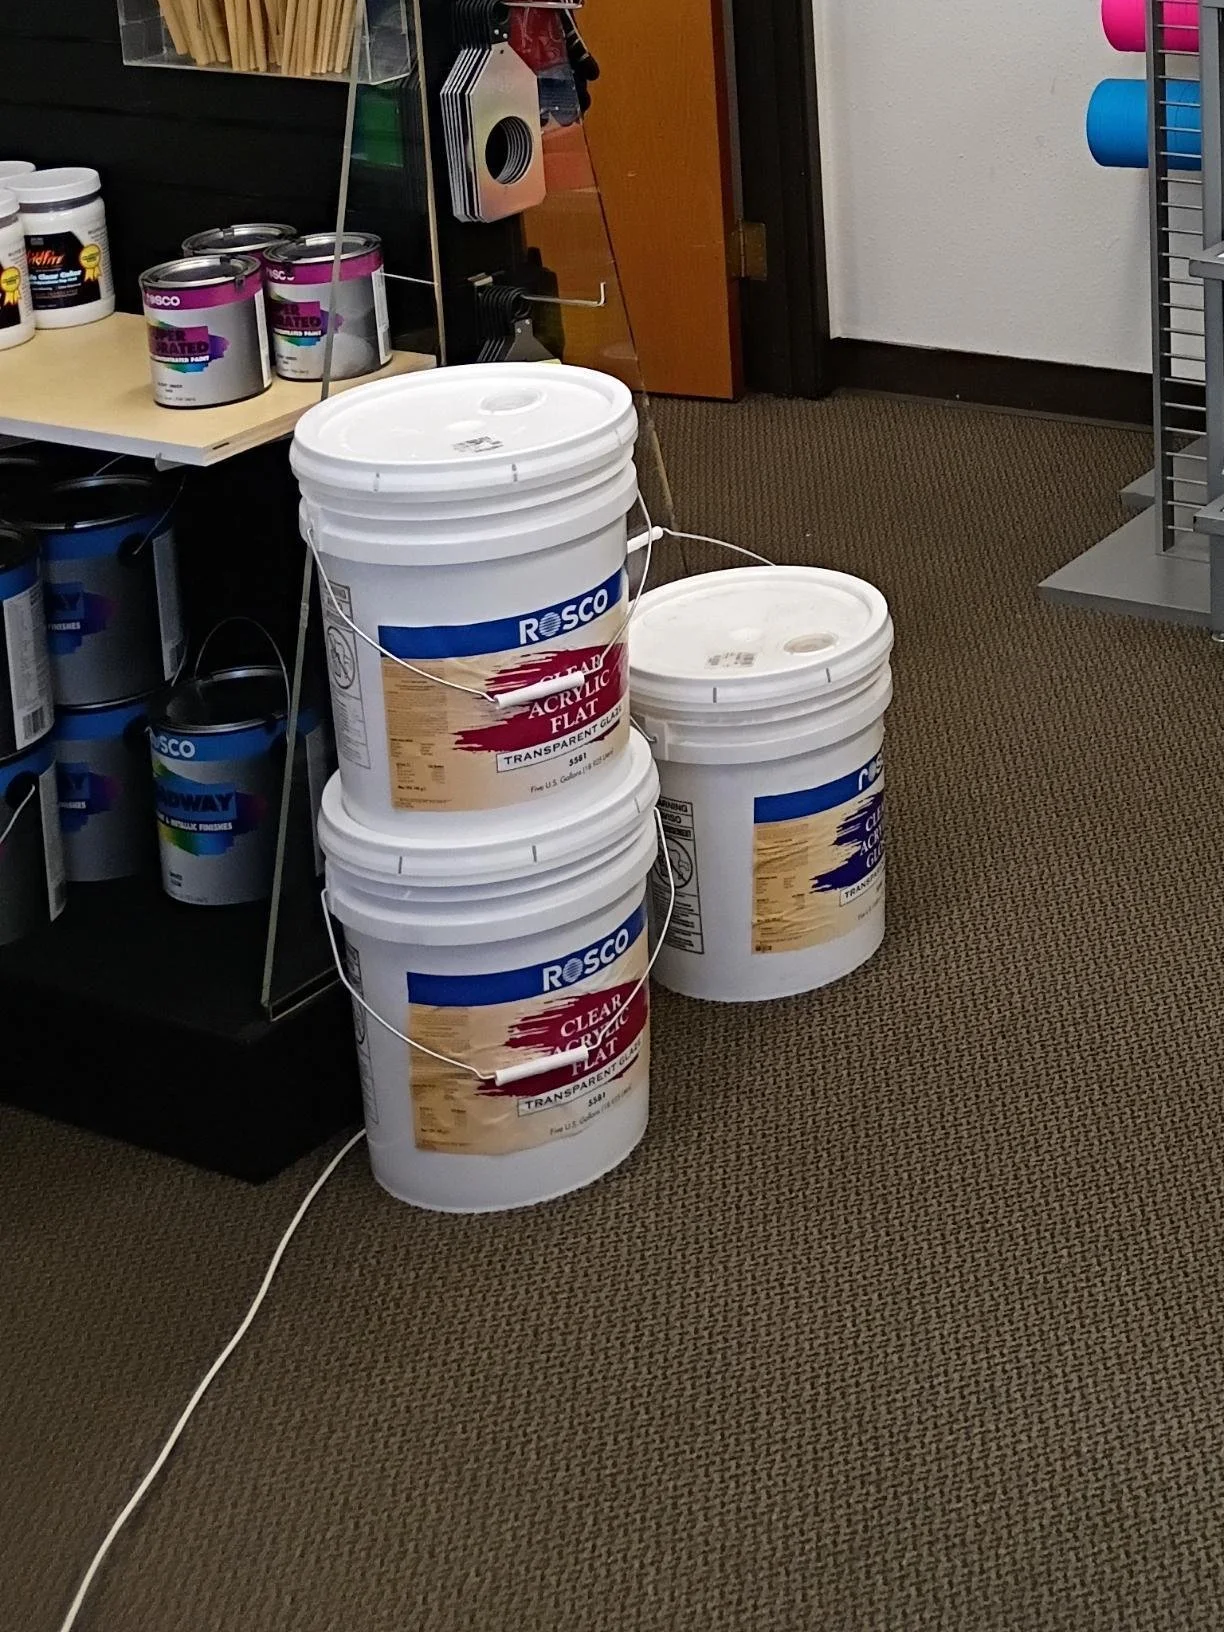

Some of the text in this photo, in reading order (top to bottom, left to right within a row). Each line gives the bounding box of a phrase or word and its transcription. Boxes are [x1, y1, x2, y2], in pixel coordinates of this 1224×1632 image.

[28, 250, 65, 267] ildfire
[150, 341, 210, 356] RATED
[190, 355, 210, 364] PAINT
[518, 587, 610, 647] ROSCO
[541, 652, 604, 683] LEAR
[528, 668, 613, 720] ACRYLIC
[550, 698, 601, 735] FLAT
[152, 734, 196, 759] SCO
[503, 725, 600, 766] TRANSPARENT
[568, 752, 588, 768] 5581
[530, 767, 583, 794] Five U.S. Gallons
[155, 786, 236, 814] ADWAY
[656, 801, 688, 813] ARNING
[199, 822, 233, 833] FINISHES
[660, 813, 683, 825] VISO
[543, 927, 630, 993] ROSCO
[560, 993, 622, 1039] CLEAR
[525, 1070, 616, 1110] TRANSPARENT
